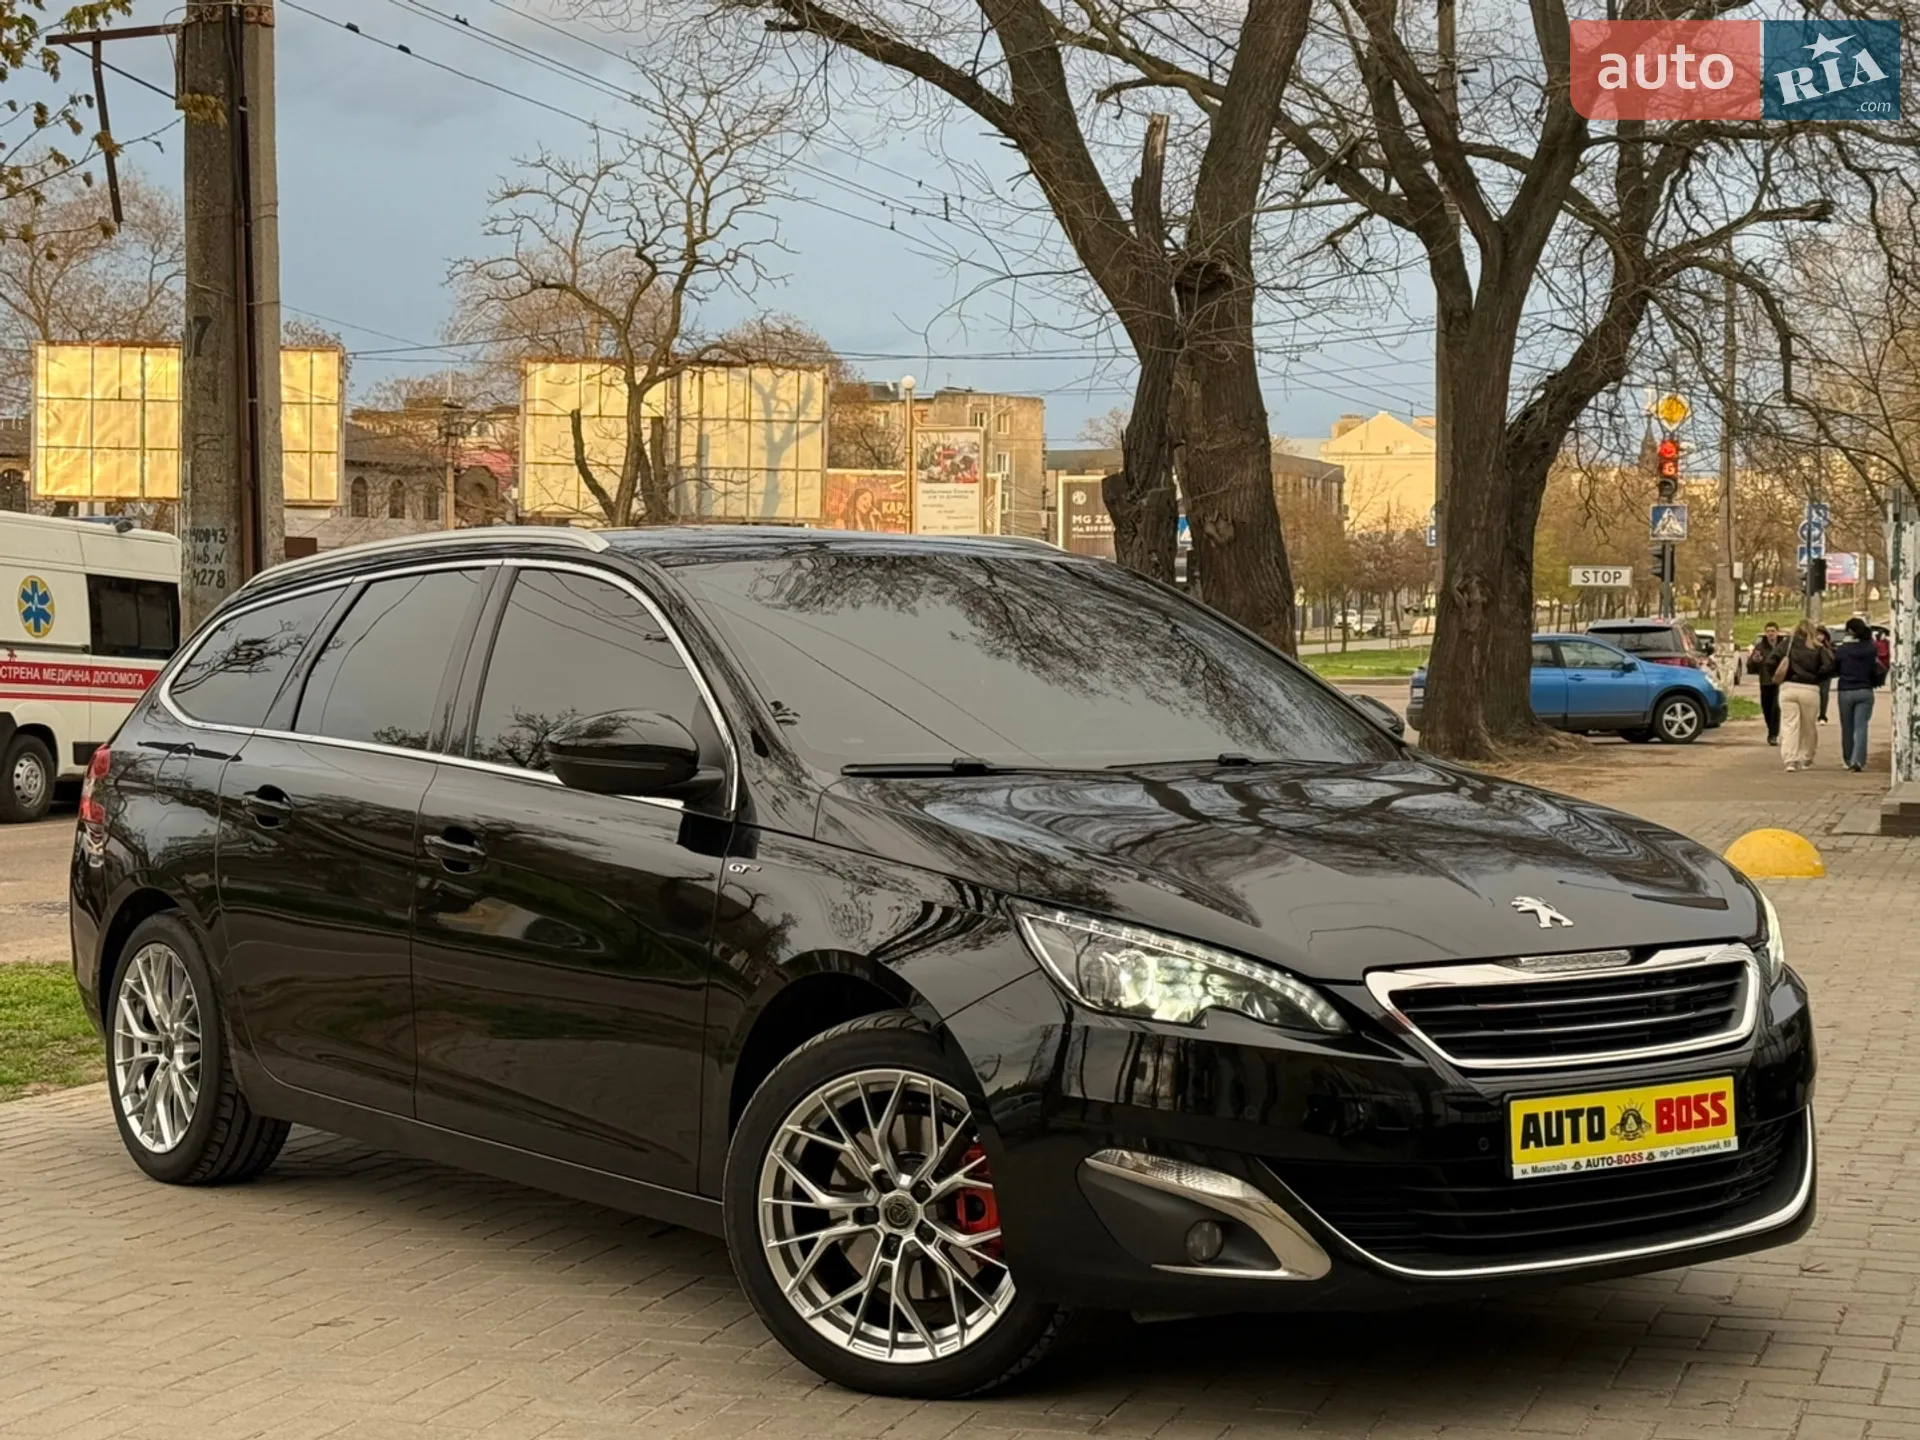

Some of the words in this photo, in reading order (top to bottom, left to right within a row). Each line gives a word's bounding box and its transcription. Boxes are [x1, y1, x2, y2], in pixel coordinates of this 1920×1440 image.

[1072, 514, 1092, 524] MG
[192, 568, 226, 589] 4278
[1581, 570, 1622, 583] STOP
[0, 665, 41, 680] СТРЕНА
[42, 668, 91, 684] МЕДИЧНА
[92, 671, 144, 686] ДОПОМОГА
[1520, 1105, 1606, 1150] AUTO
[1655, 1091, 1728, 1134] BOSS
[1585, 1152, 1644, 1169] AUTO-BOSS
